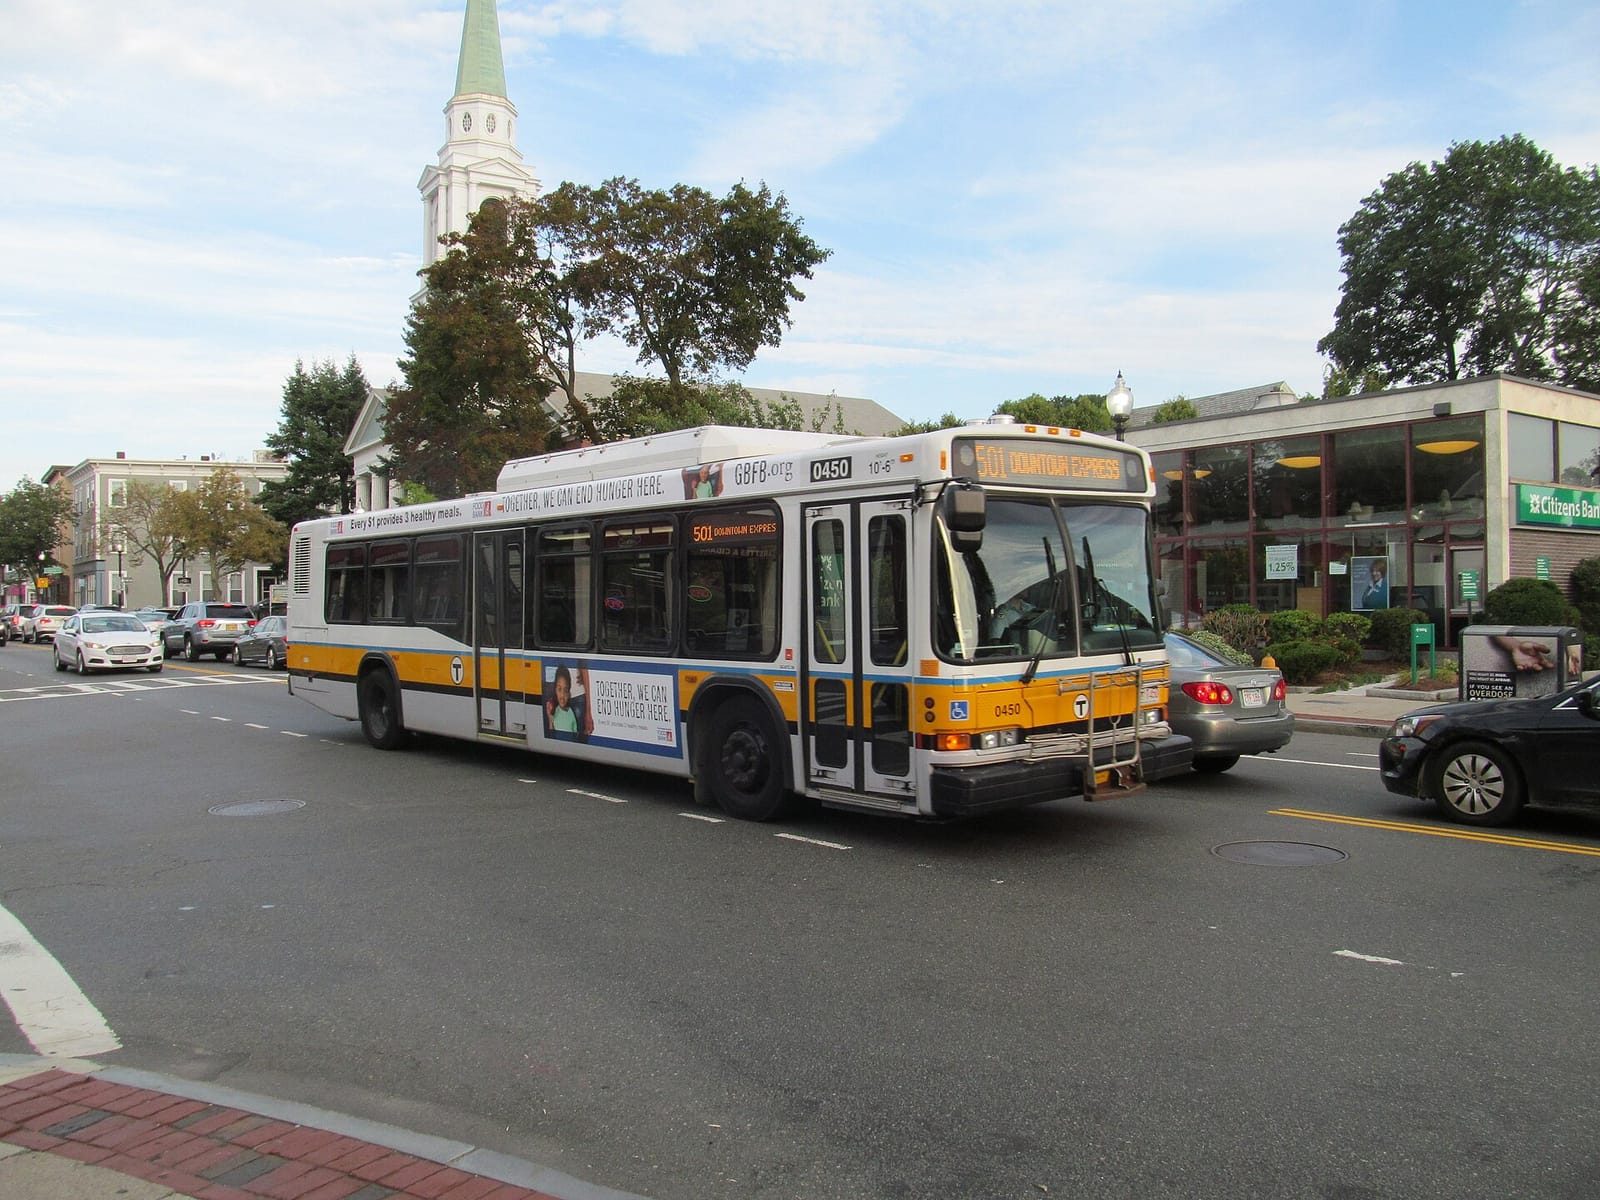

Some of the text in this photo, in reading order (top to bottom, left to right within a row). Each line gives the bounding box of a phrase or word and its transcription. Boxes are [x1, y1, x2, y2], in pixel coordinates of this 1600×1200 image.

[735, 460, 793, 486] GBFB.org
[813, 459, 848, 480] 0450
[975, 445, 1120, 480] 501 DOWNTOWN EXPRESS
[502, 475, 665, 512] TOGETHER, WE CAN END HUNGER HERE.
[1541, 495, 1600, 518] Citizens Ban
[350, 519, 367, 531] Every
[368, 516, 375, 528] $1
[376, 514, 403, 528] provides
[405, 513, 409, 523] 3
[410, 510, 436, 524] healthy
[437, 507, 462, 519] meals.
[693, 523, 777, 542] 501 DOWNTOWN EXPRES
[1268, 562, 1295, 572] 1.25%
[821, 592, 840, 607] ank
[452, 663, 462, 682] T
[596, 680, 667, 703] TOGETHER, WE CAN
[1469, 689, 1513, 698] OVERDOSE
[597, 698, 672, 722] END HUNGER HERE.
[995, 703, 1020, 717] 0450
[1075, 700, 1087, 716] T
